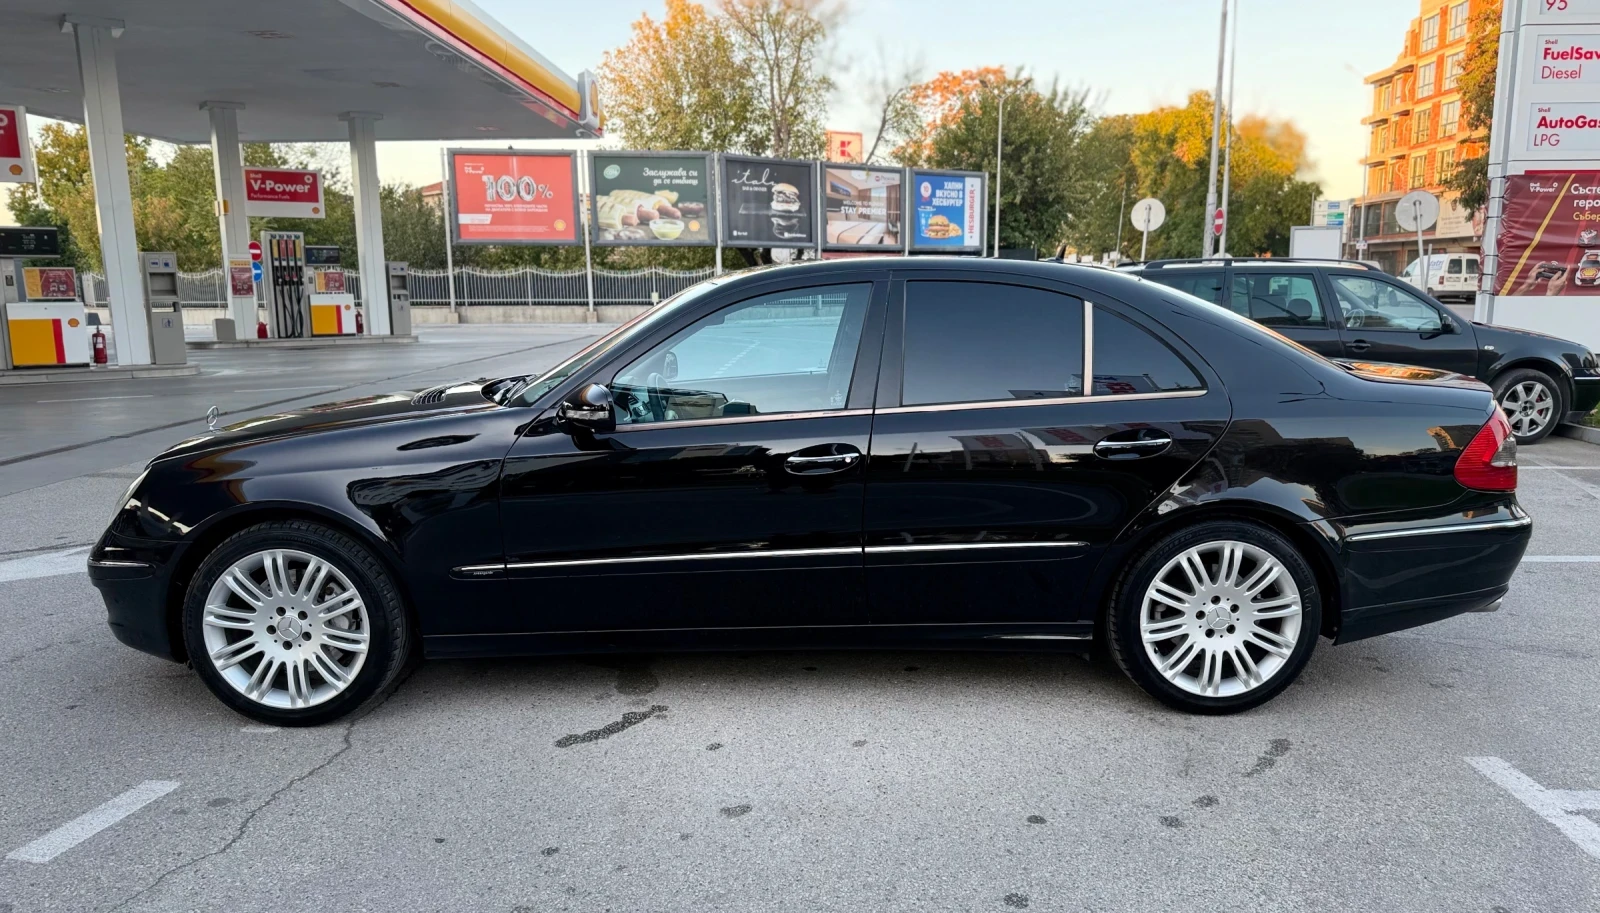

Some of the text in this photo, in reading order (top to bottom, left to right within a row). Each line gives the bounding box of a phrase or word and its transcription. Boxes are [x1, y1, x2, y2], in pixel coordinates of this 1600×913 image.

[1541, 64, 1582, 79] Diesel
[1533, 133, 1560, 147] LPG
[643, 167, 687, 178] Заслужава
[250, 179, 310, 193] V-Power
[936, 189, 958, 198] ВКУСНО
[932, 198, 963, 206] ХЕСБУРГЕР
[841, 206, 887, 216] STAY PREMIER
[968, 189, 976, 234] HESBURGER
